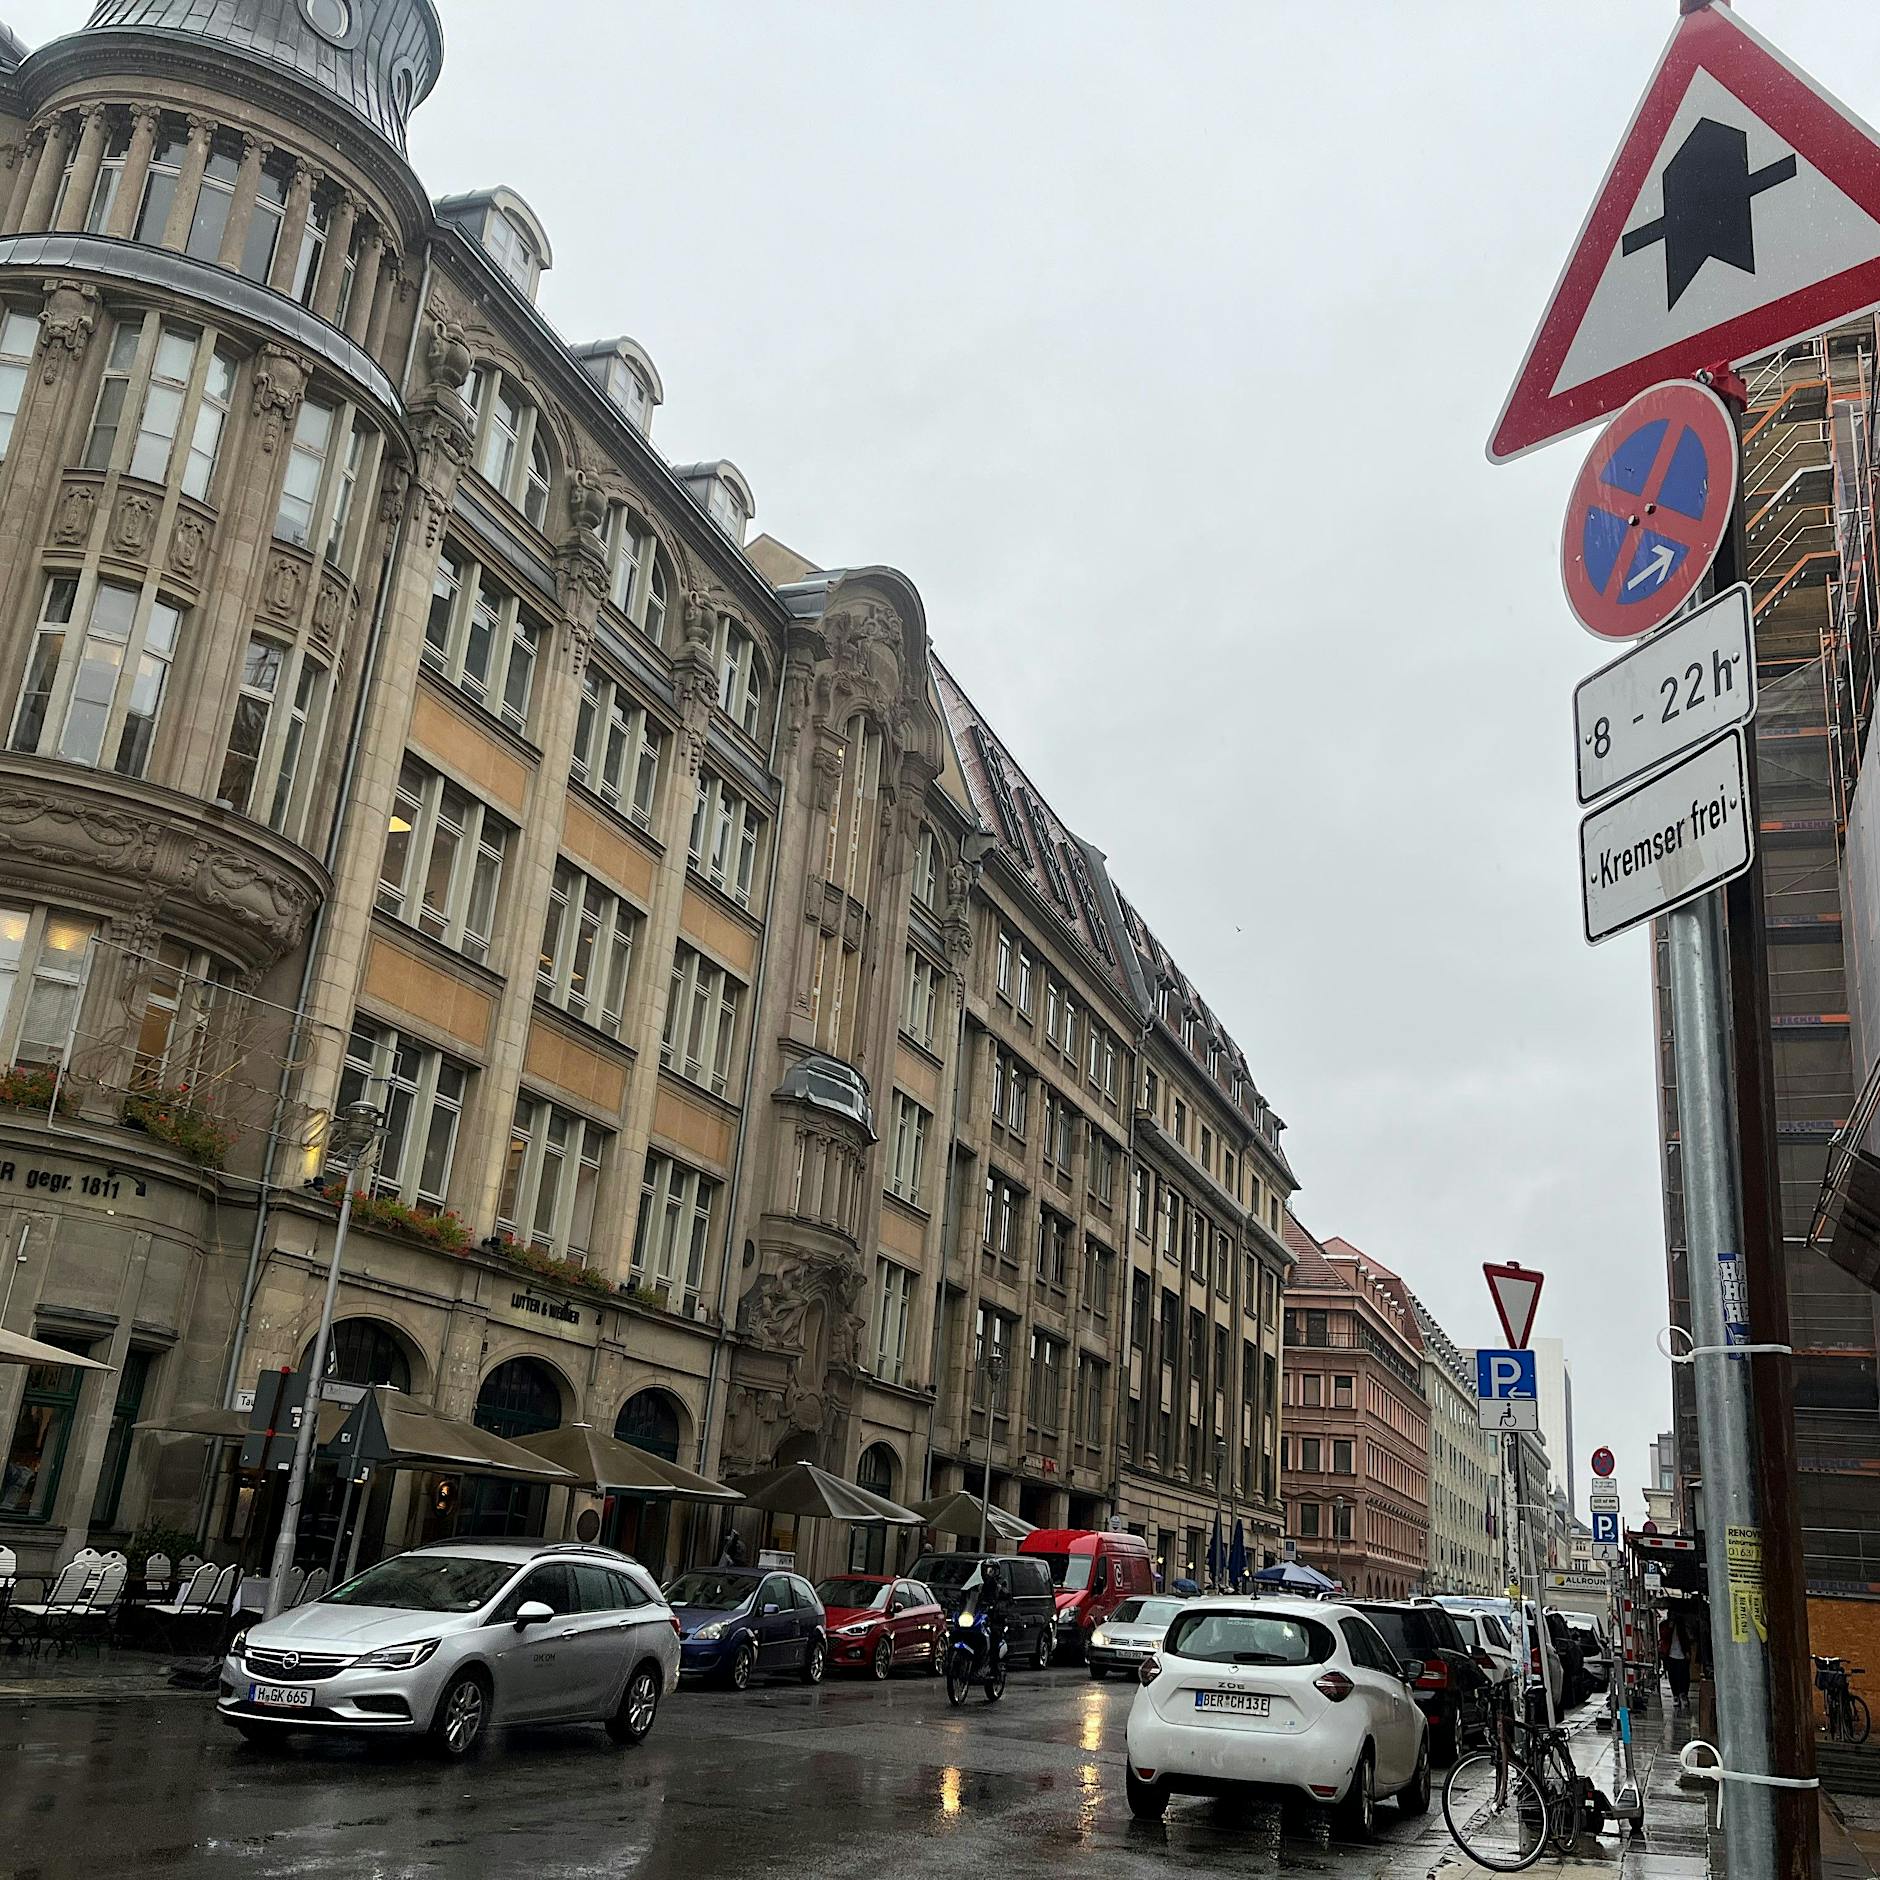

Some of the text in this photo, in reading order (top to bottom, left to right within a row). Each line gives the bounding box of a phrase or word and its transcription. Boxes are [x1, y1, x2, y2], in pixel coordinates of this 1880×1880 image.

[1594, 716, 1610, 759] 8
[1660, 662, 1705, 724] 22
[1712, 649, 1734, 698] h
[1600, 784, 1727, 889] Kremser frei
[26, 1169, 72, 1193] gegr.
[81, 1175, 120, 1199] 1811
[511, 1292, 540, 1314] LUTTER
[541, 1302, 548, 1316] &
[1490, 1357, 1522, 1399] P
[1598, 1515, 1613, 1540] P
[1218, 1681, 1245, 1689] ZOE
[1204, 1694, 1223, 1707] BER
